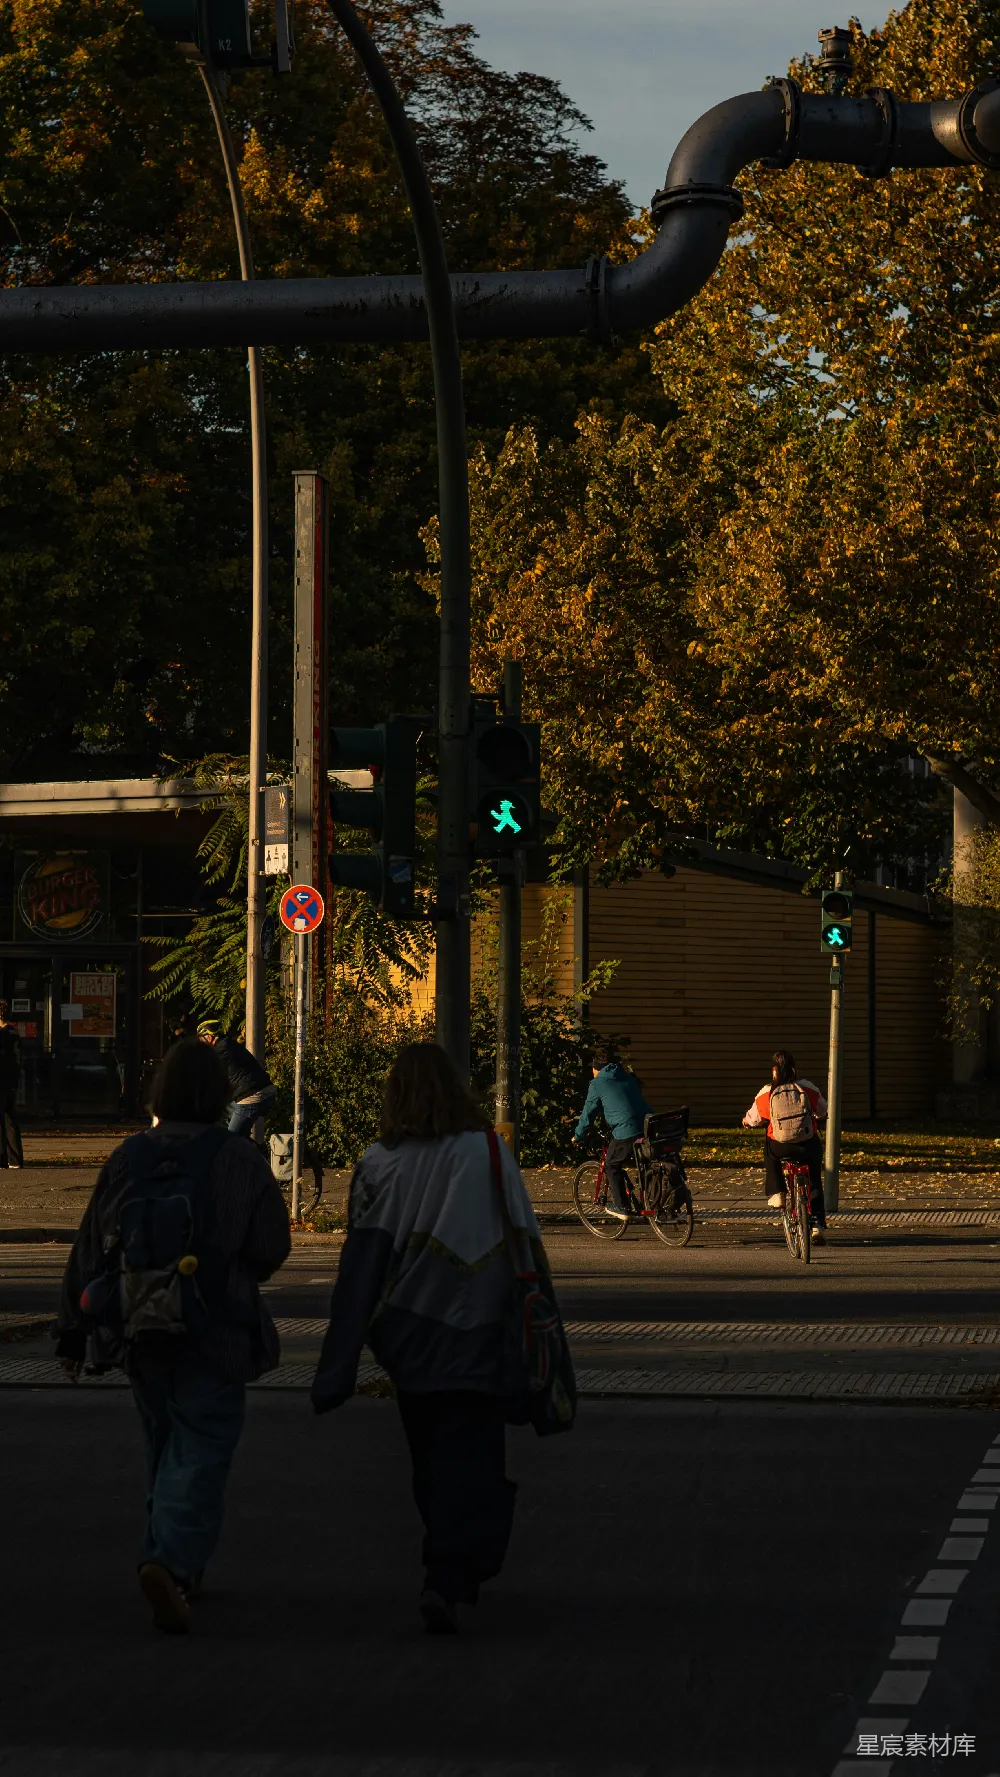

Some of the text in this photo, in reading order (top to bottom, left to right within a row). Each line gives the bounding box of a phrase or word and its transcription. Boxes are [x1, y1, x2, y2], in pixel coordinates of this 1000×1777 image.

[218, 39, 232, 51] K2
[312, 640, 320, 728] KING
[28, 868, 98, 900] BURGER
[32, 882, 101, 924] KING
[74, 984, 114, 996] CHICKEN
